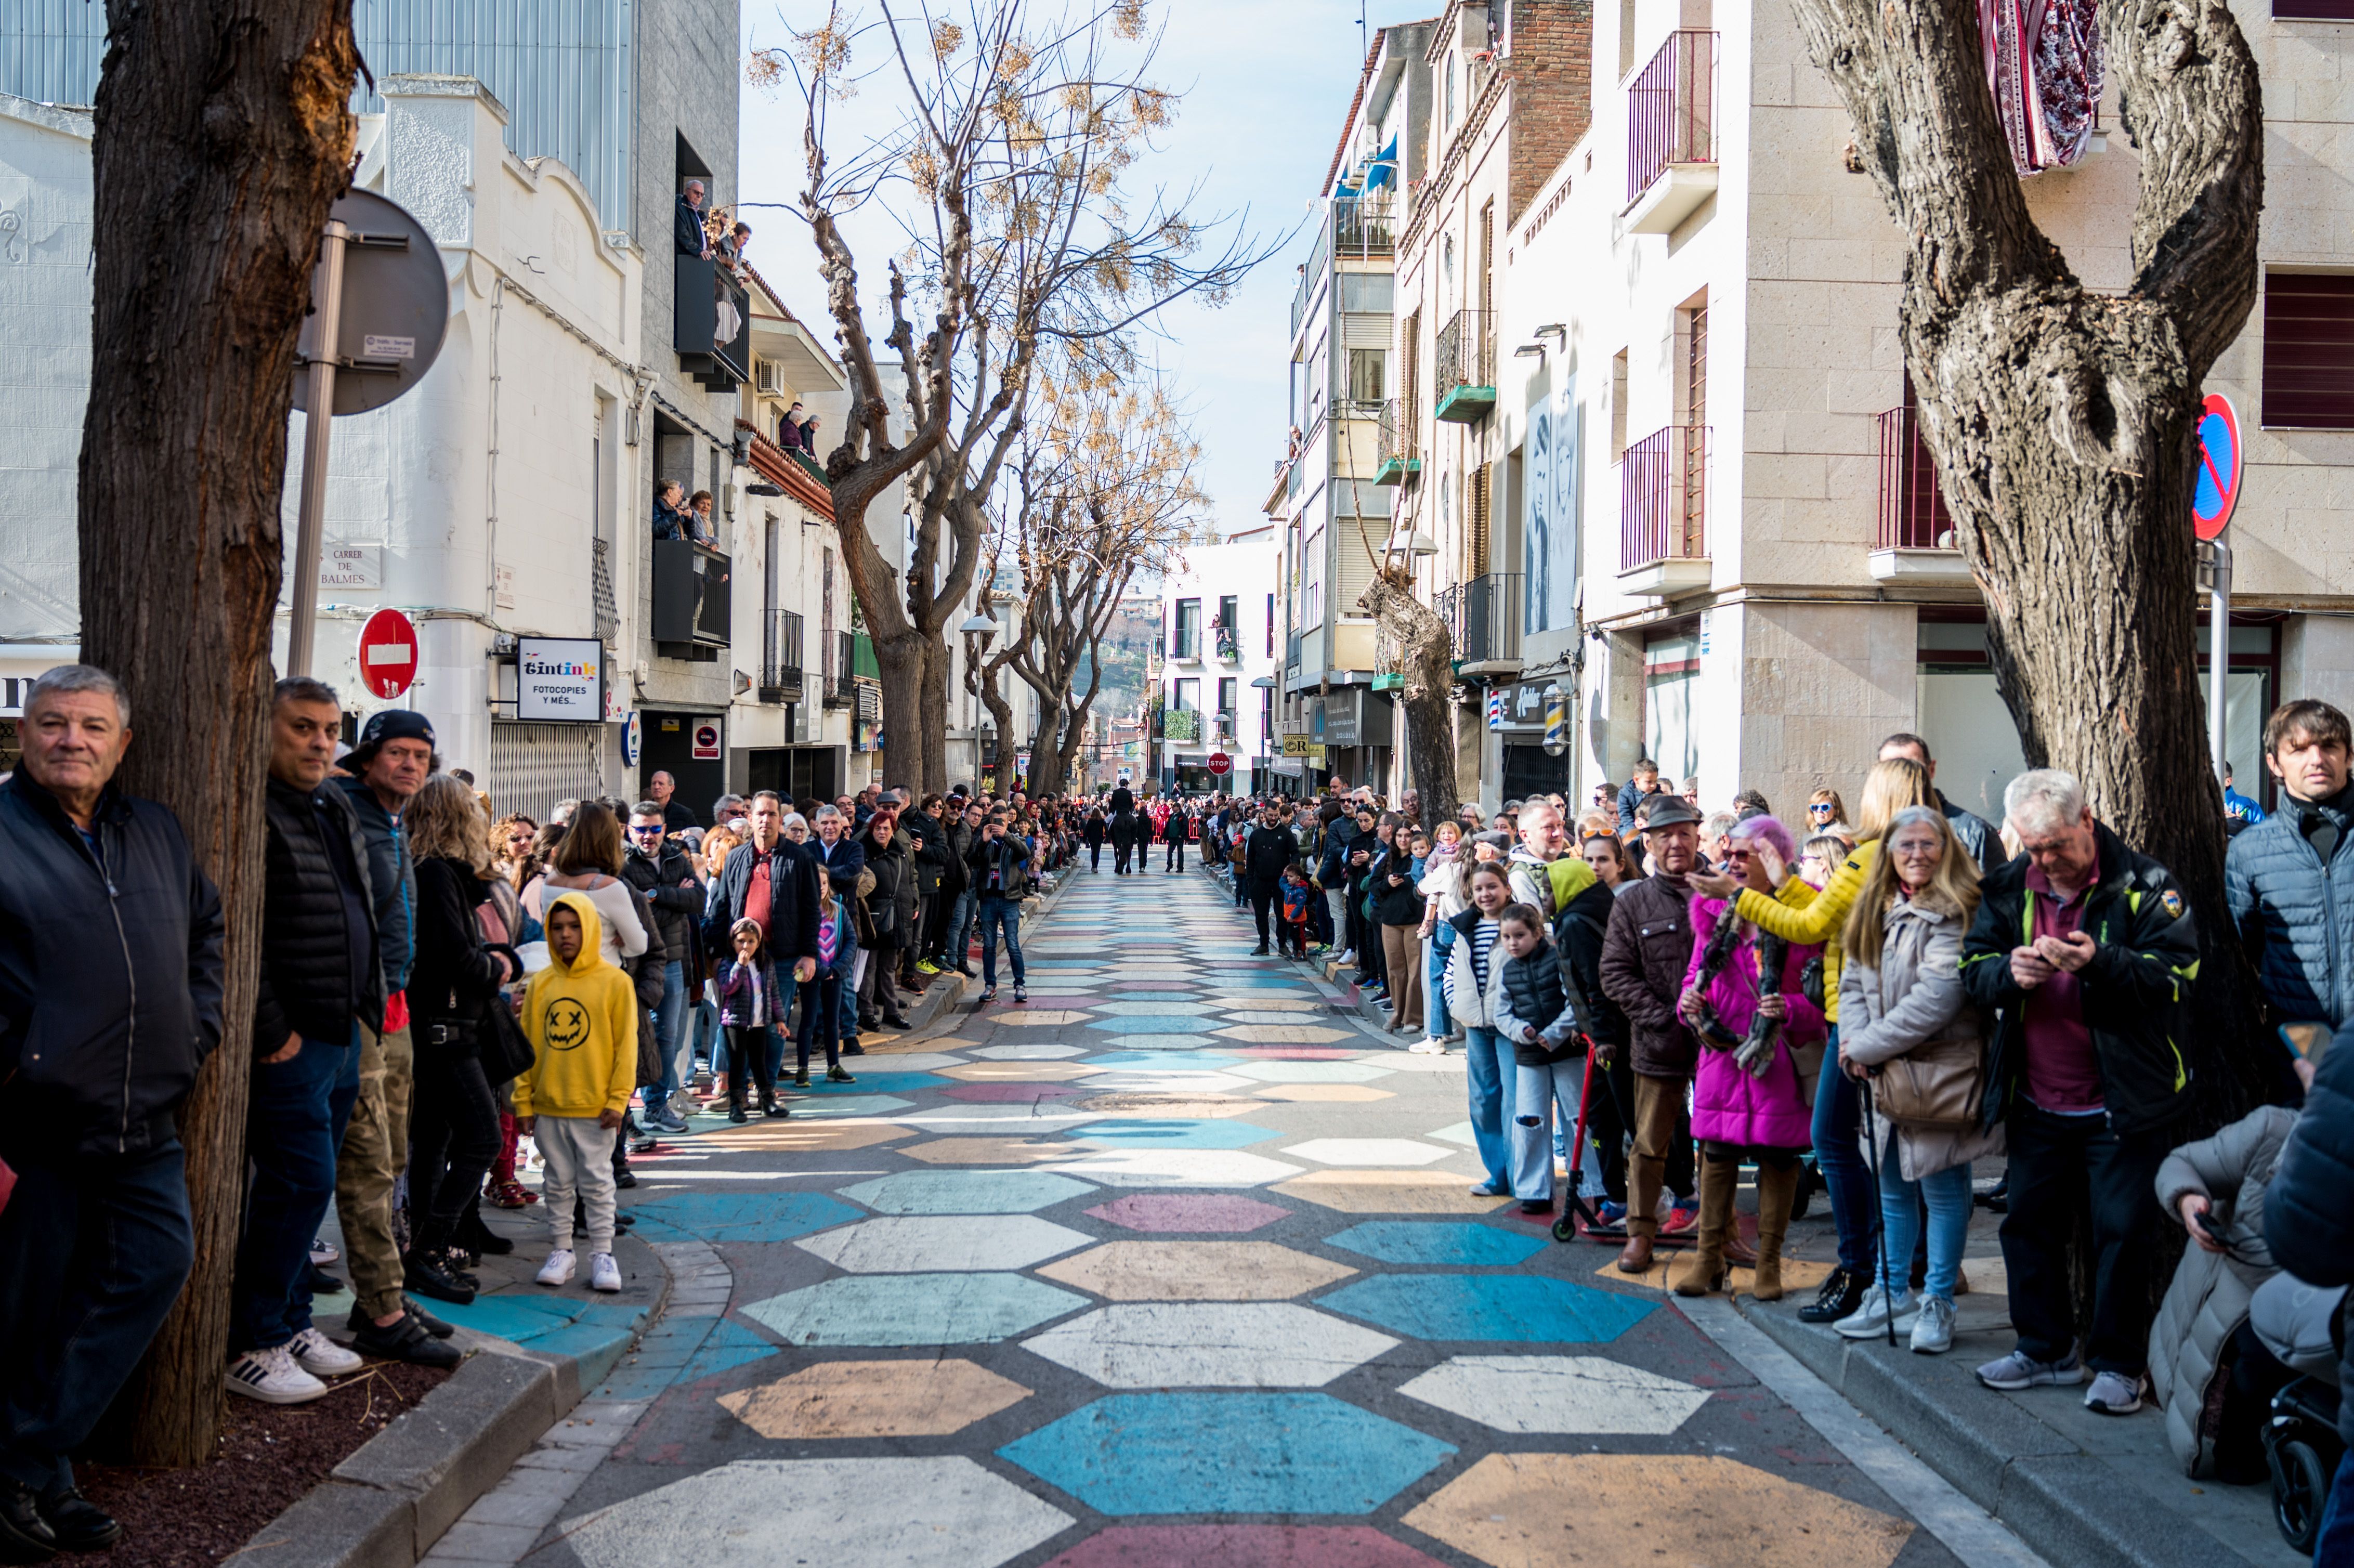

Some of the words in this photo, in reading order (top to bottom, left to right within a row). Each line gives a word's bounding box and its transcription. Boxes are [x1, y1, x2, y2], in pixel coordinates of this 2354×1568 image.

[333, 550, 362, 558] CARRER
[338, 562, 352, 570] DE
[321, 574, 364, 583] BALMES
[524, 661, 596, 675] tintink
[533, 686, 586, 695] FOTOCOPIES
